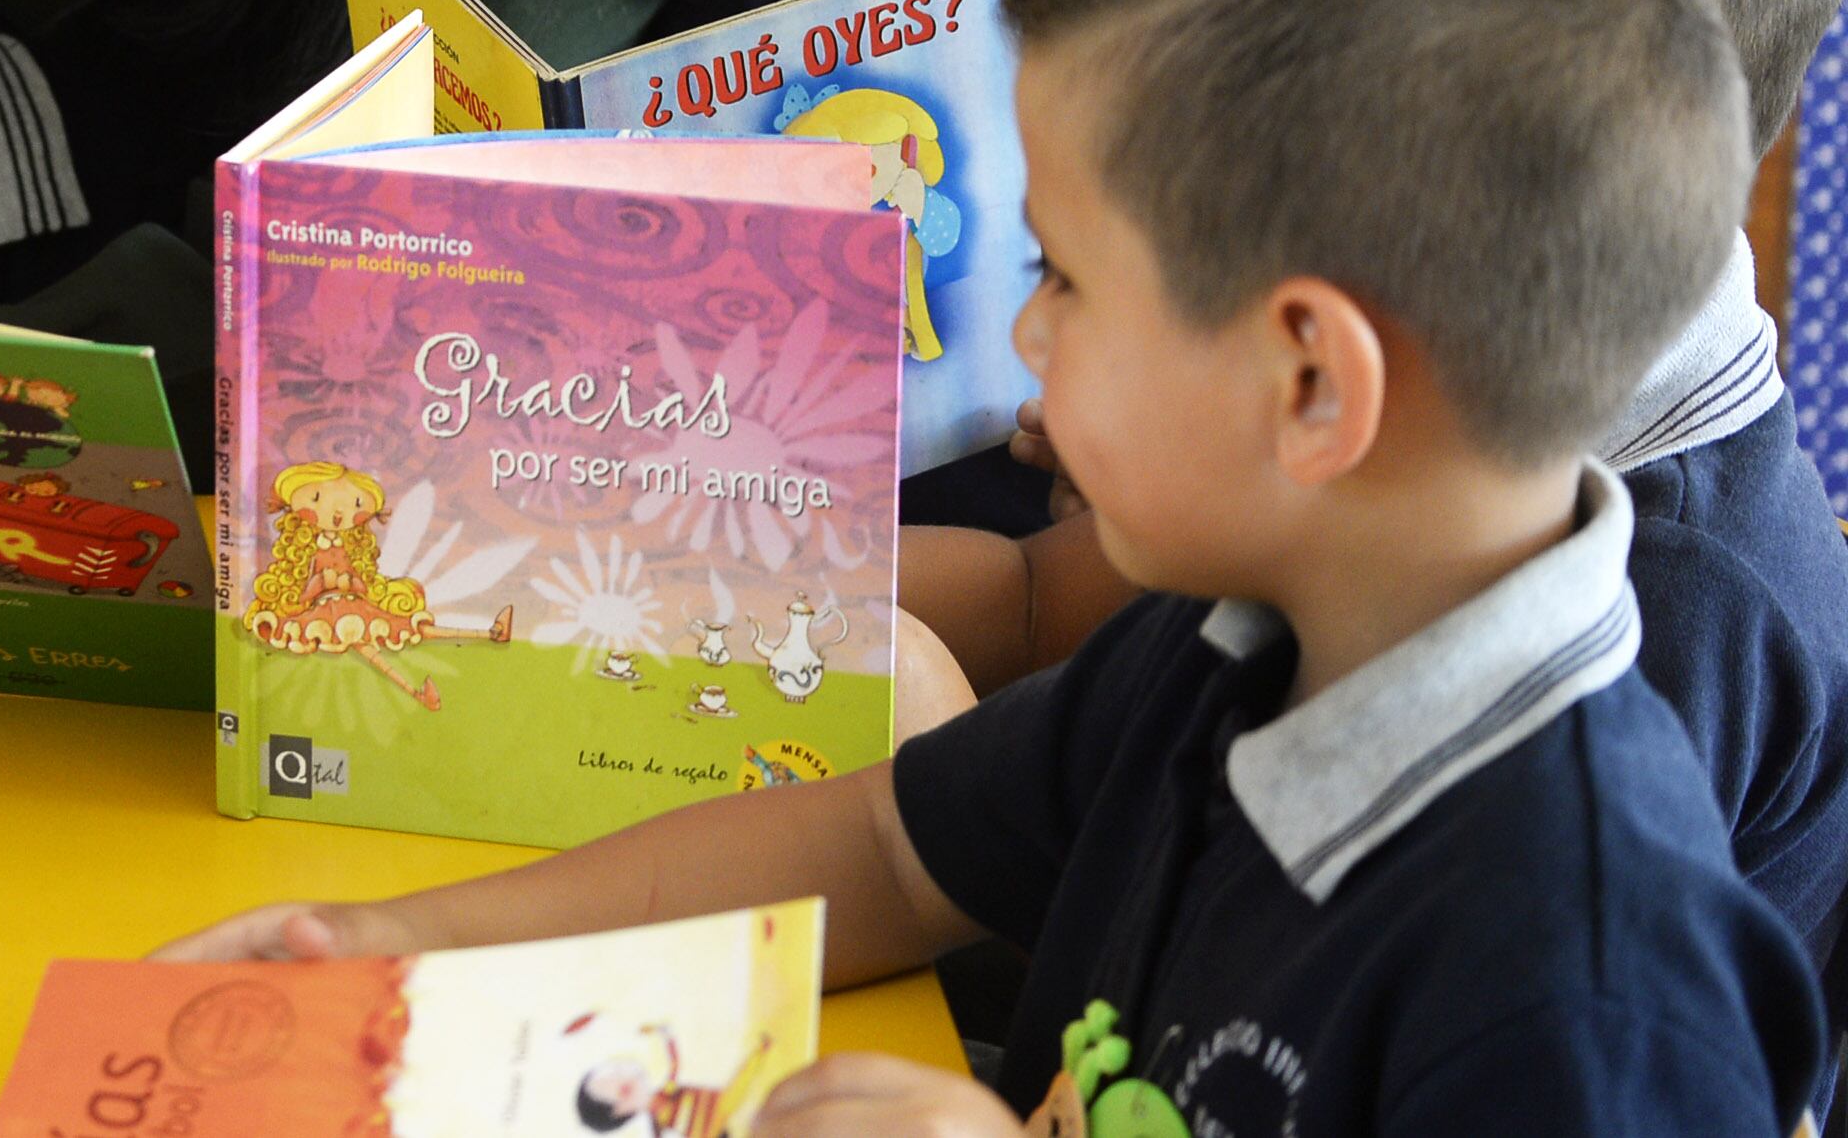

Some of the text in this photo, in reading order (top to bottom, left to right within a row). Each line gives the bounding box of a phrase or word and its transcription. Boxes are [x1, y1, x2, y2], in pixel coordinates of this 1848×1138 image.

[642, 33, 784, 128] ¿QUÉ
[266, 220, 474, 257] Cristina Portorrico
[330, 256, 353, 271] por
[356, 253, 432, 281] Rodrigo
[437, 260, 526, 287] Folgueira
[413, 331, 733, 439] Gracias
[215, 376, 234, 611] Gracias por ser mi amiga
[489, 447, 834, 518] por ser mi amiga
[577, 749, 729, 785] Libros de regalo
